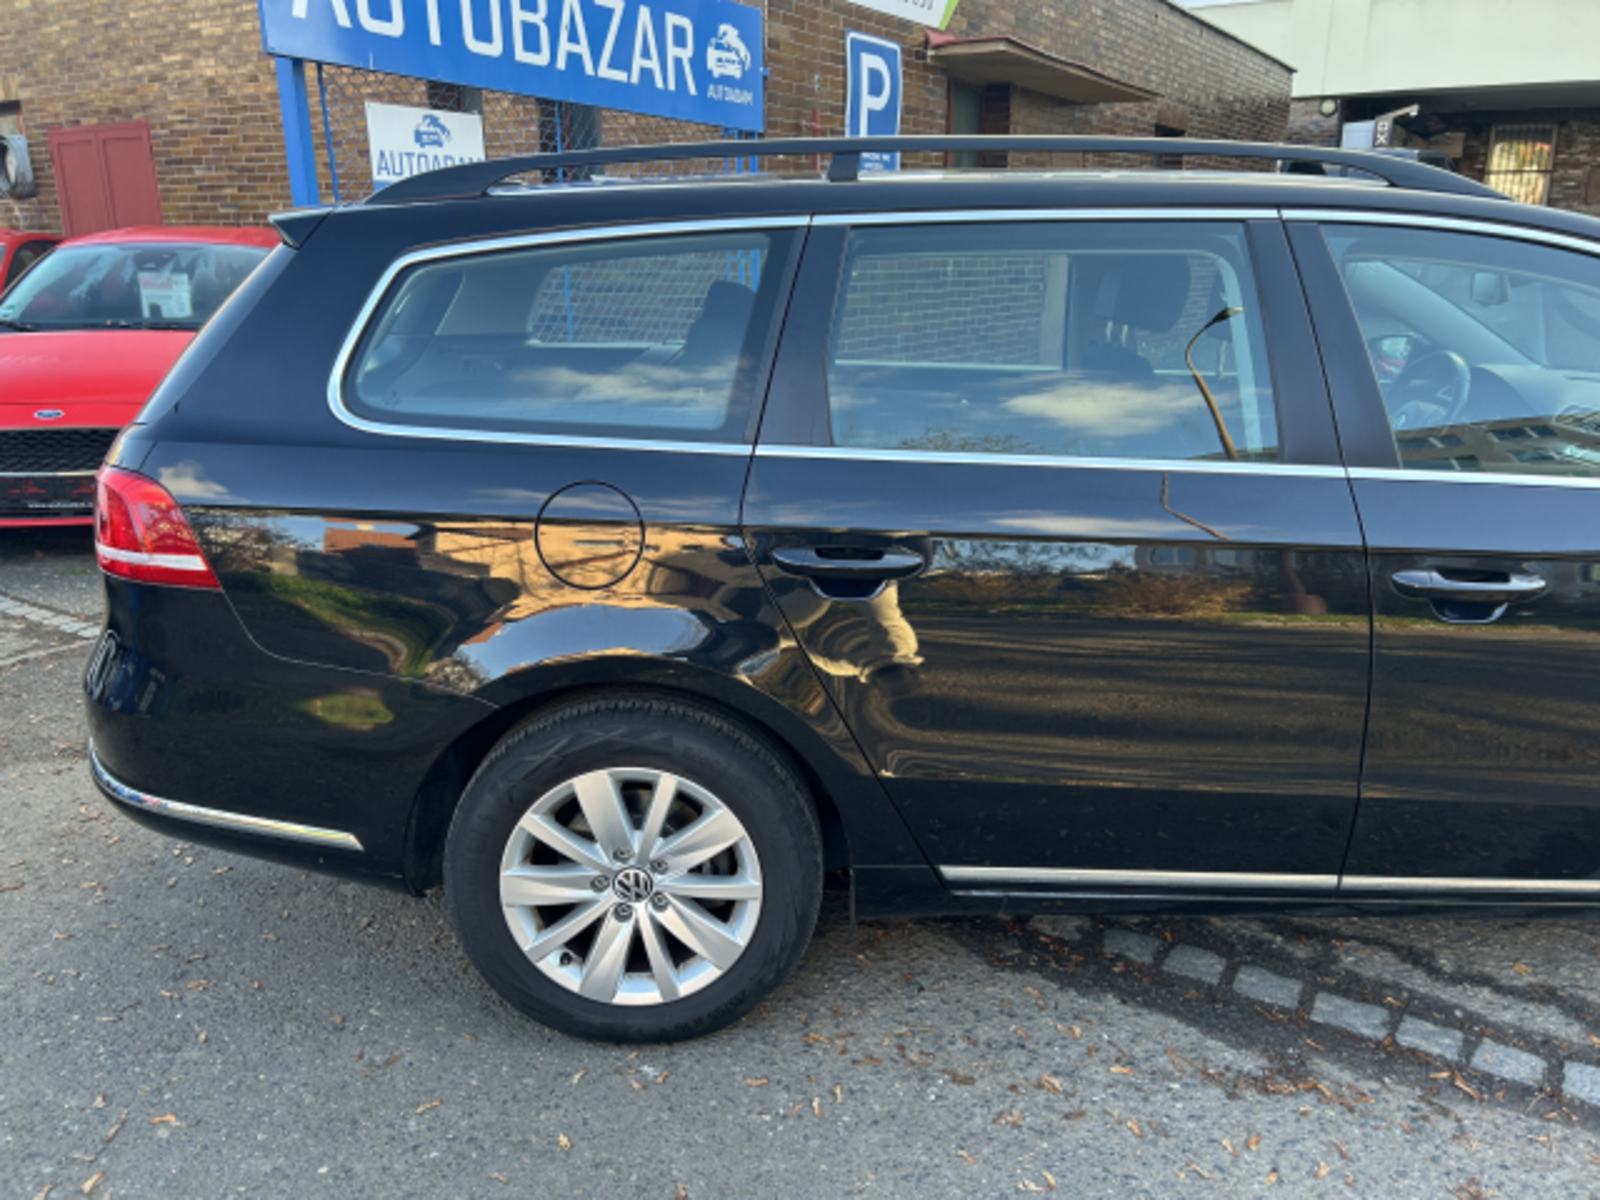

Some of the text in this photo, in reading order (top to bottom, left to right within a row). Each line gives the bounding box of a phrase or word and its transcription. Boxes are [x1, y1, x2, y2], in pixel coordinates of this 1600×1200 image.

[292, 0, 698, 96] OBAZAR
[859, 52, 891, 137] P
[377, 149, 483, 176] AUTOAD
